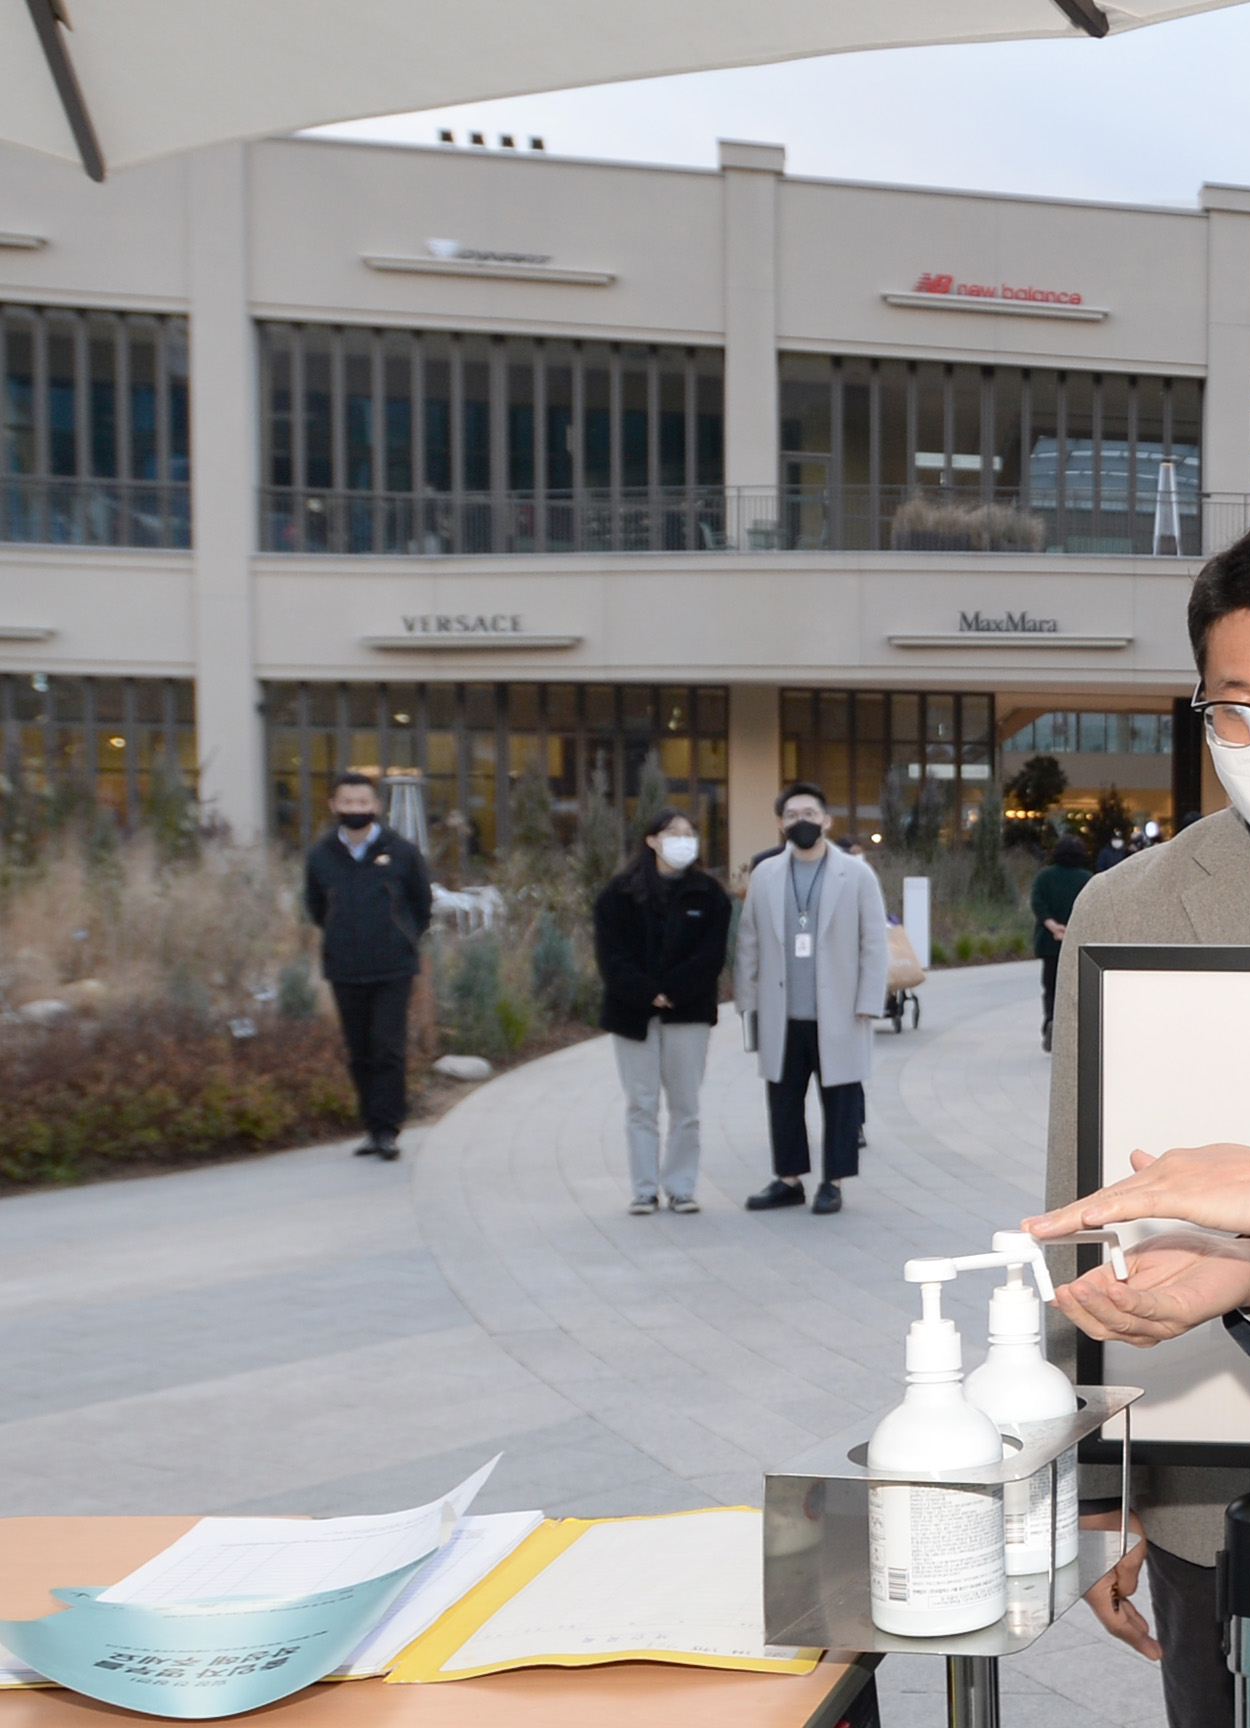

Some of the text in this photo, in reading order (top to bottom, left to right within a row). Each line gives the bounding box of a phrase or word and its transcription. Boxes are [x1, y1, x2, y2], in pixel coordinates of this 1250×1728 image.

[957, 283, 996, 298] new
[1002, 284, 1082, 305] balance
[401, 613, 525, 632] VERSACE
[959, 610, 1058, 632] MaxMara
[108, 1652, 202, 1668] 주세요
